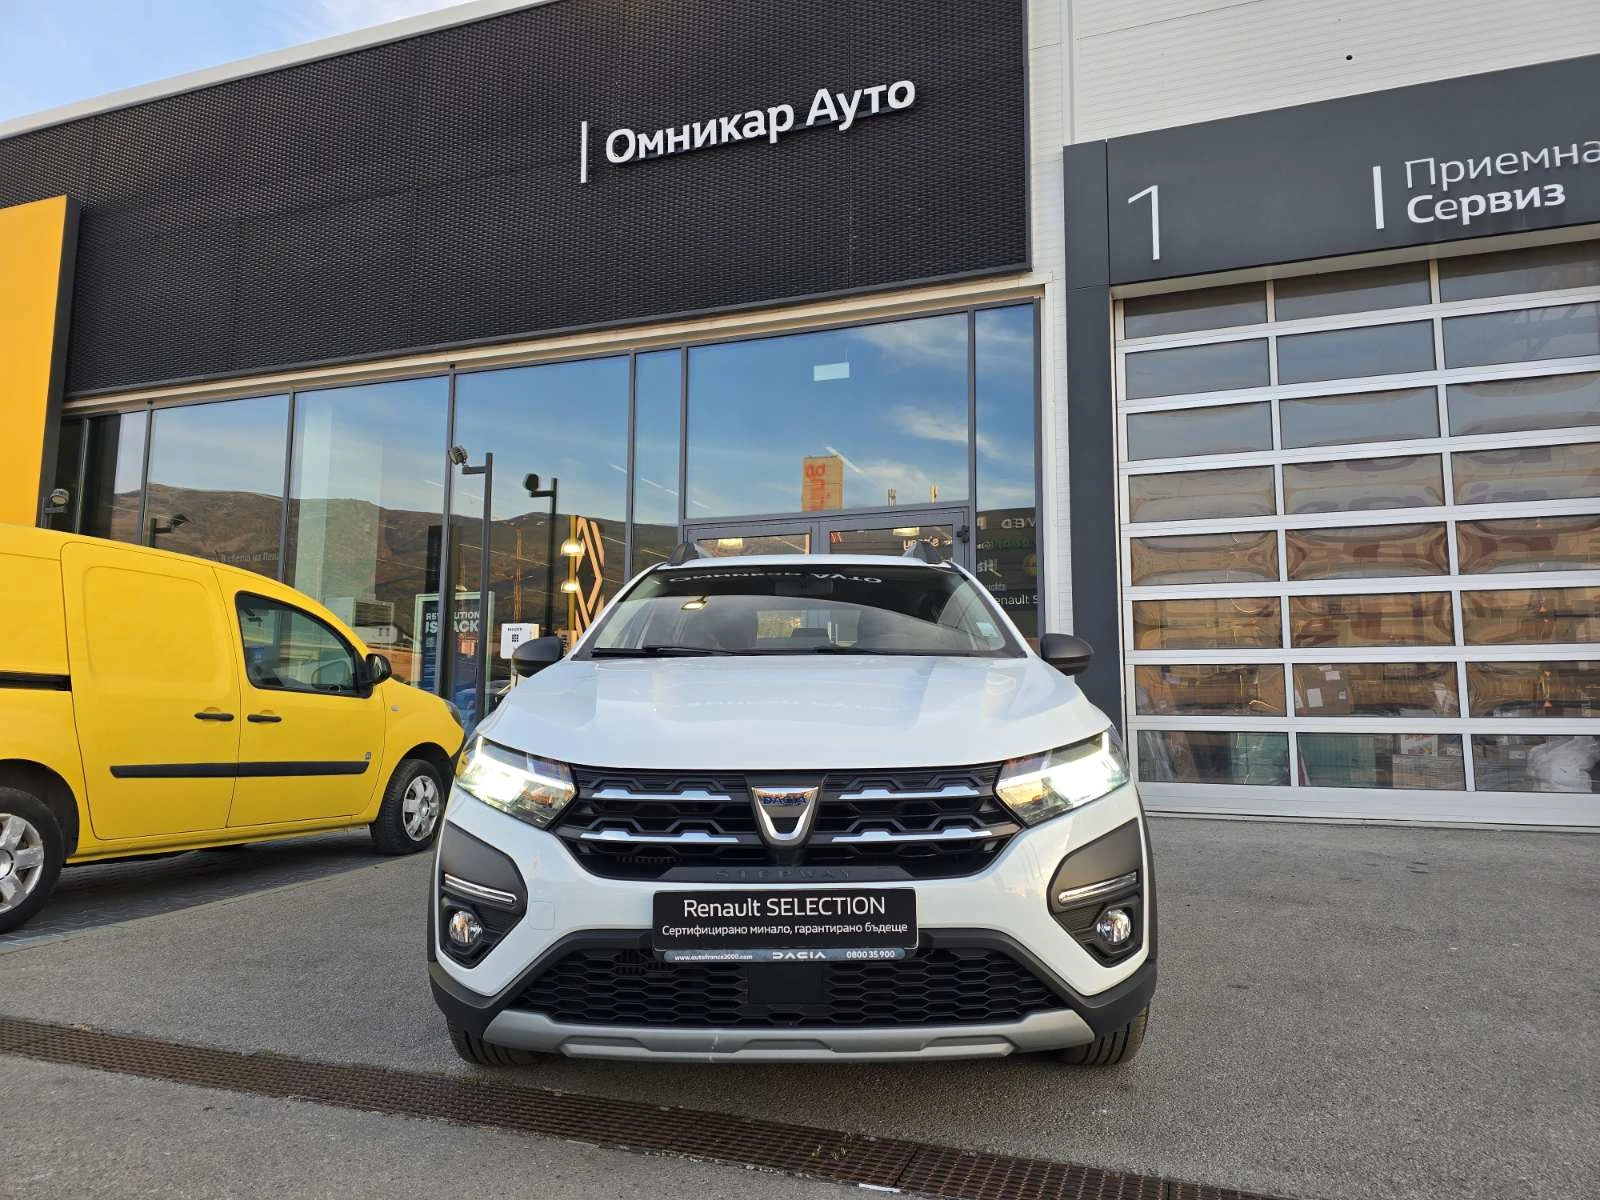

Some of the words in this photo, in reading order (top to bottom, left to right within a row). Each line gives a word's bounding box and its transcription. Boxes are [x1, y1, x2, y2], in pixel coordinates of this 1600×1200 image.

[605, 103, 795, 164] Омникар
[806, 80, 916, 132] Ауто
[1404, 140, 1600, 191] Приемна
[1407, 183, 1566, 226] Сервиз
[1127, 184, 1161, 261] 1
[995, 594, 1029, 606] enault
[453, 620, 480, 633] ACK
[683, 898, 761, 918] Renault
[766, 896, 886, 917] SELECTION
[662, 924, 748, 938] Сертифицирано
[749, 924, 793, 936] минало,
[794, 924, 863, 936] гарантирано
[864, 921, 909, 934] бъдеще
[772, 951, 827, 960] DACIA
[845, 950, 867, 959] 0800
[868, 950, 878, 958] 35
[879, 950, 896, 958] 900
